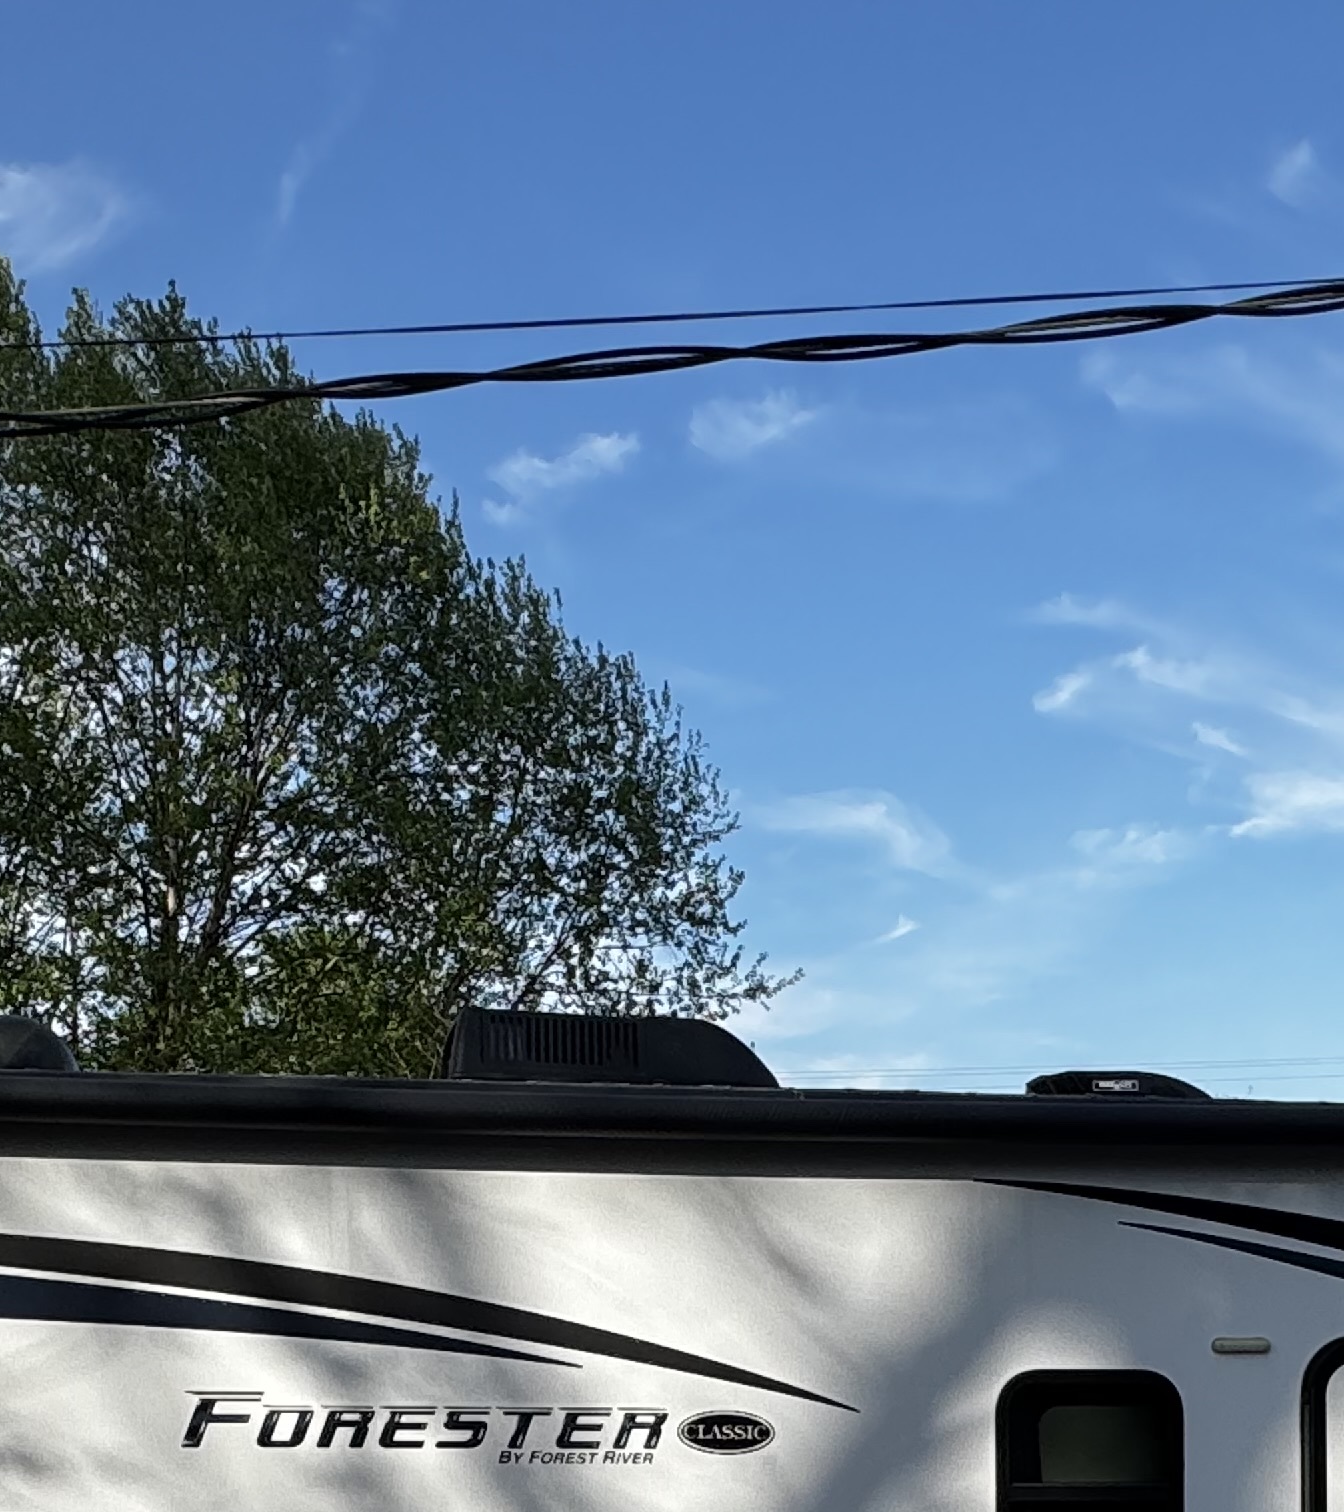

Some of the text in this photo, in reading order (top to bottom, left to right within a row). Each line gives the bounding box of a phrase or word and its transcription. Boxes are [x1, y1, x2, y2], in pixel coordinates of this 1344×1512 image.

[181, 1391, 668, 1448] FORESTER
[683, 1424, 768, 1441] CLASSIC
[498, 1450, 654, 1464] BY FOREST RIVER
